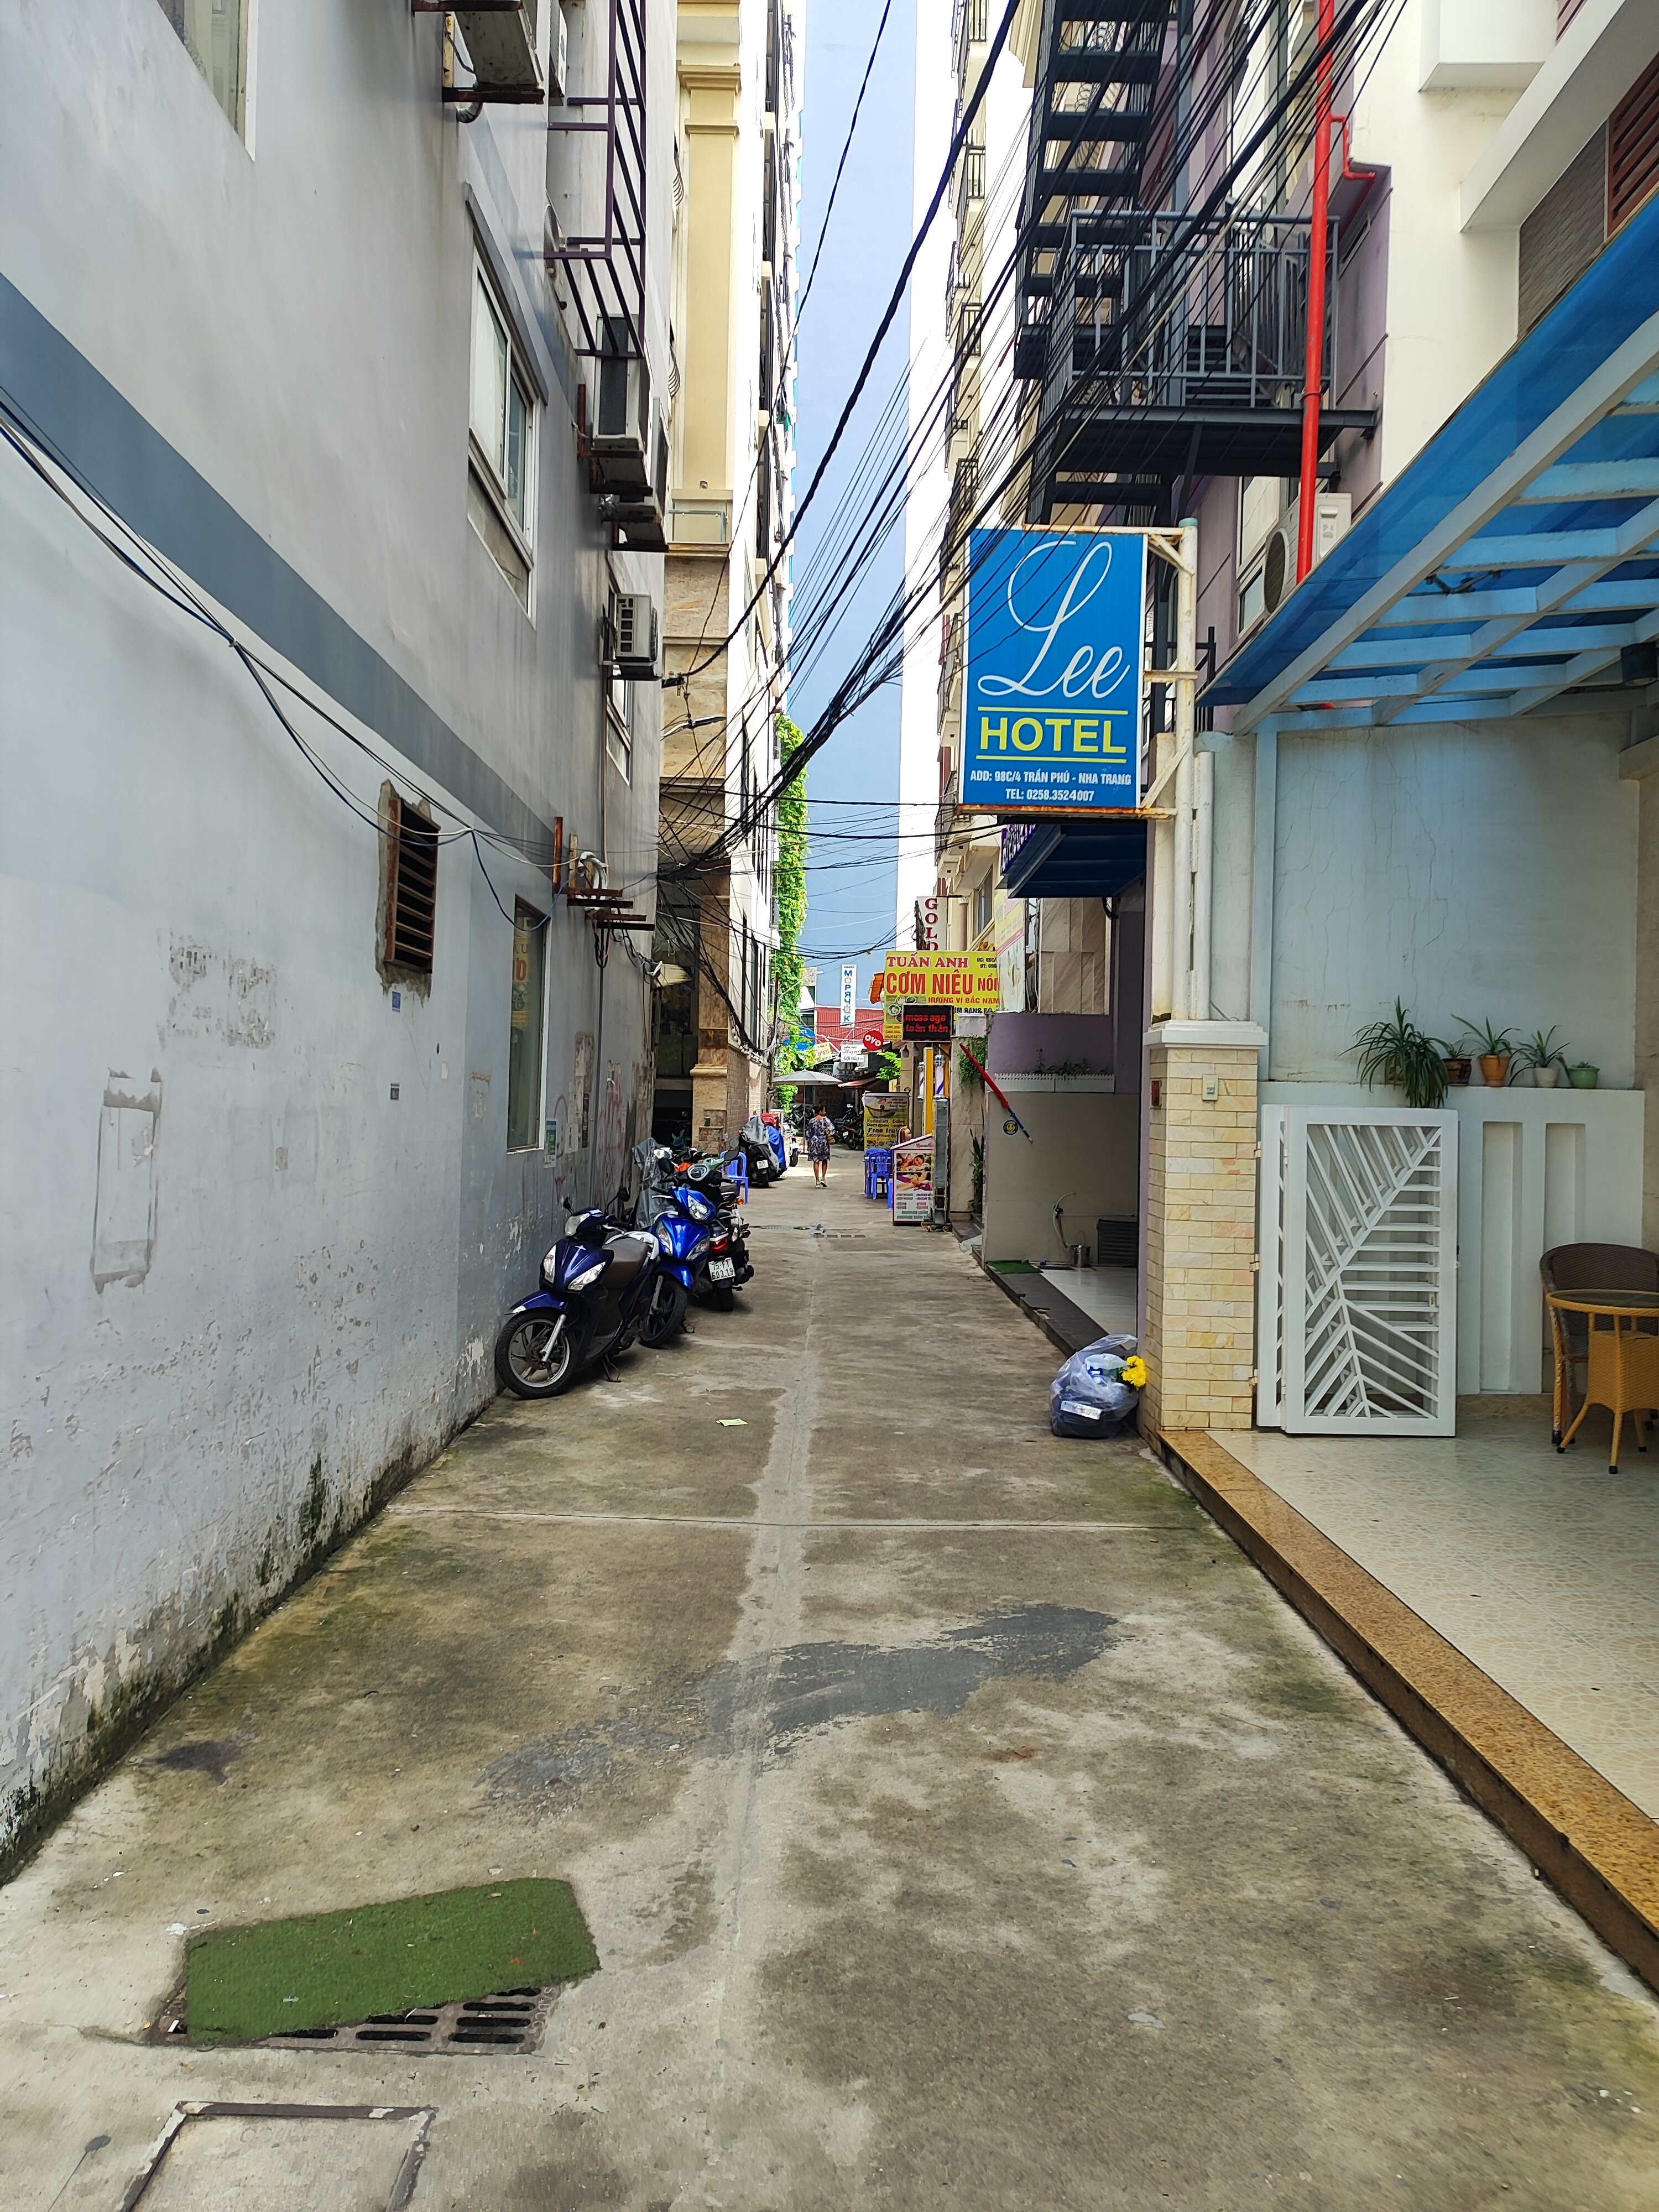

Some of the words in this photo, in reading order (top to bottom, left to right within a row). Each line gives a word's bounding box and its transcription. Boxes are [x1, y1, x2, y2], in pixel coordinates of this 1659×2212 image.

[978, 541, 1130, 698] Lee
[980, 717, 1126, 753] HOTEL
[970, 770, 992, 781] ADD:
[994, 771, 1021, 782] 98C/4
[1051, 770, 1070, 784] PHÚ
[1078, 773, 1099, 784] NHA
[1100, 774, 1131, 785] TRANG
[1006, 789, 1024, 800] TEL:
[1026, 789, 1095, 801] 0258.3524007
[925, 898, 939, 951] GOLD
[886, 952, 930, 968] TUẤN
[935, 957, 968, 968] ANH
[886, 971, 926, 995] CƠM
[932, 969, 973, 995] NIÊU
[864, 1034, 881, 1047] OYO
